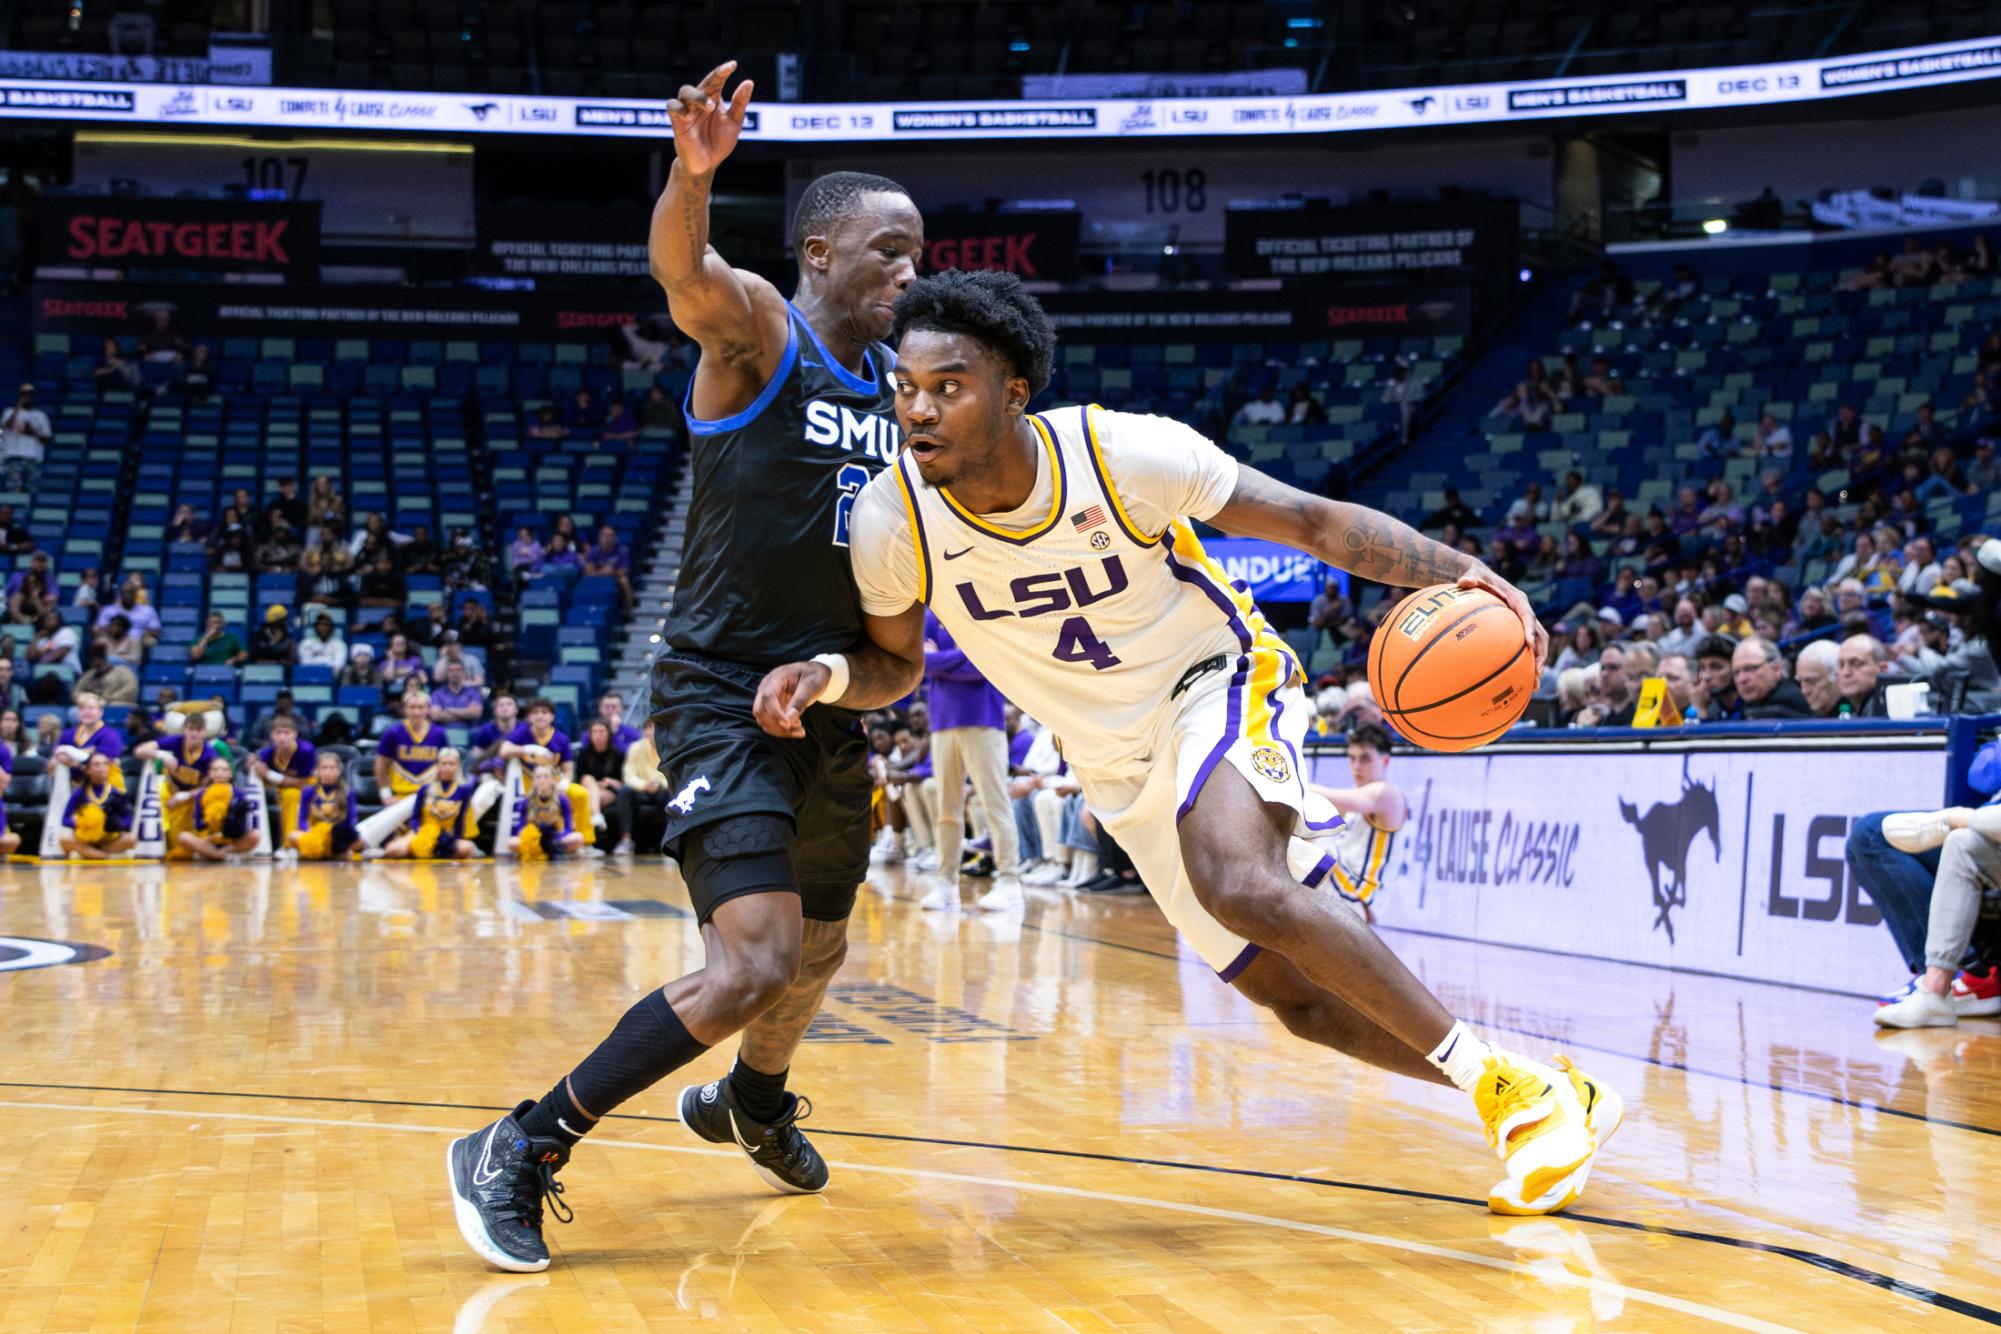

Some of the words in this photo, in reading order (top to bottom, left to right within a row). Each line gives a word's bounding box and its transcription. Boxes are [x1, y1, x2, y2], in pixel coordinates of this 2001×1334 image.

[1718, 79, 1767, 94] DEC
[1779, 76, 1799, 89] 13
[8, 90, 131, 109] BASKETBALL
[216, 98, 252, 111] LSU
[1456, 96, 1490, 110] LSU
[1512, 90, 1565, 107] MEN'S
[1568, 83, 1683, 105] BASKETBALL
[522, 108, 557, 120] LSU
[792, 116, 841, 129] DEC
[851, 116, 874, 129] 13
[896, 114, 976, 128] WOMEN'S
[979, 111, 1093, 126] BASKETBALL
[1172, 110, 1208, 123] LSU
[242, 158, 308, 200] 107
[1141, 168, 1207, 214] 108
[68, 215, 290, 263] SEATGEEK
[916, 232, 1039, 276] GEEK
[504, 258, 528, 273] THE
[43, 300, 128, 319] SEATGEEK
[1327, 304, 1408, 327] SEATGEEK
[805, 400, 899, 465] SMU
[1091, 532, 1109, 549] SEC
[955, 554, 1128, 621] LSU
[1052, 616, 1122, 671] 4
[1436, 808, 1492, 884] CAUSE
[1494, 809, 1581, 888] CLASSIC
